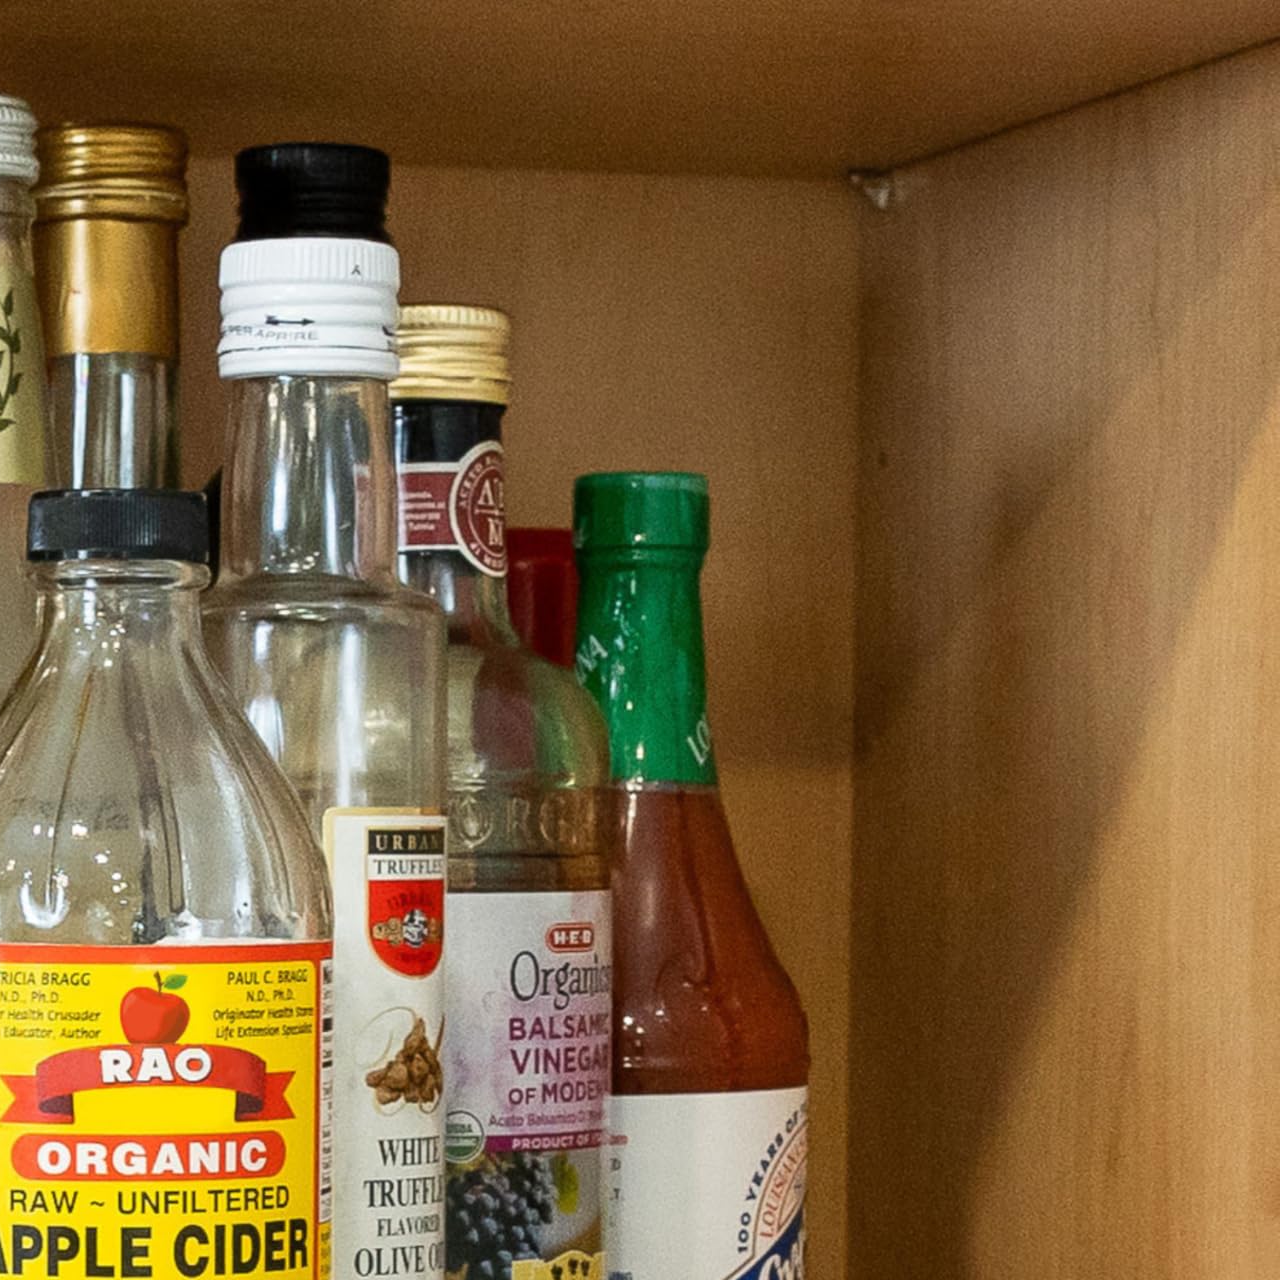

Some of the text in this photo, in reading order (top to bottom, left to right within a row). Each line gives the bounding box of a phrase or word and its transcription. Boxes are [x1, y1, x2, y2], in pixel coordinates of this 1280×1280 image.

[41, 972, 91, 986] BRAGG
[227, 971, 260, 985] PAUL
[277, 969, 308, 983] BRAGG
[8, 1009, 43, 1020] Health
[48, 1010, 101, 1022] Crusader
[213, 1007, 265, 1023] Originator
[60, 1027, 101, 1039] Author
[216, 1025, 234, 1040] Life
[98, 1047, 214, 1085] RAO
[508, 1087, 537, 1106] OF
[378, 1136, 441, 1166] WHITE
[512, 1136, 574, 1150] PRODUCT
[37, 1139, 267, 1176] ORGANIC
[9, 1185, 289, 1214] RAW UNFILTERED
[738, 1212, 752, 1253] 100
[746, 1132, 784, 1200] YEARS
[173, 1218, 309, 1278] CIDER
[354, 1244, 425, 1278] OLIVE
